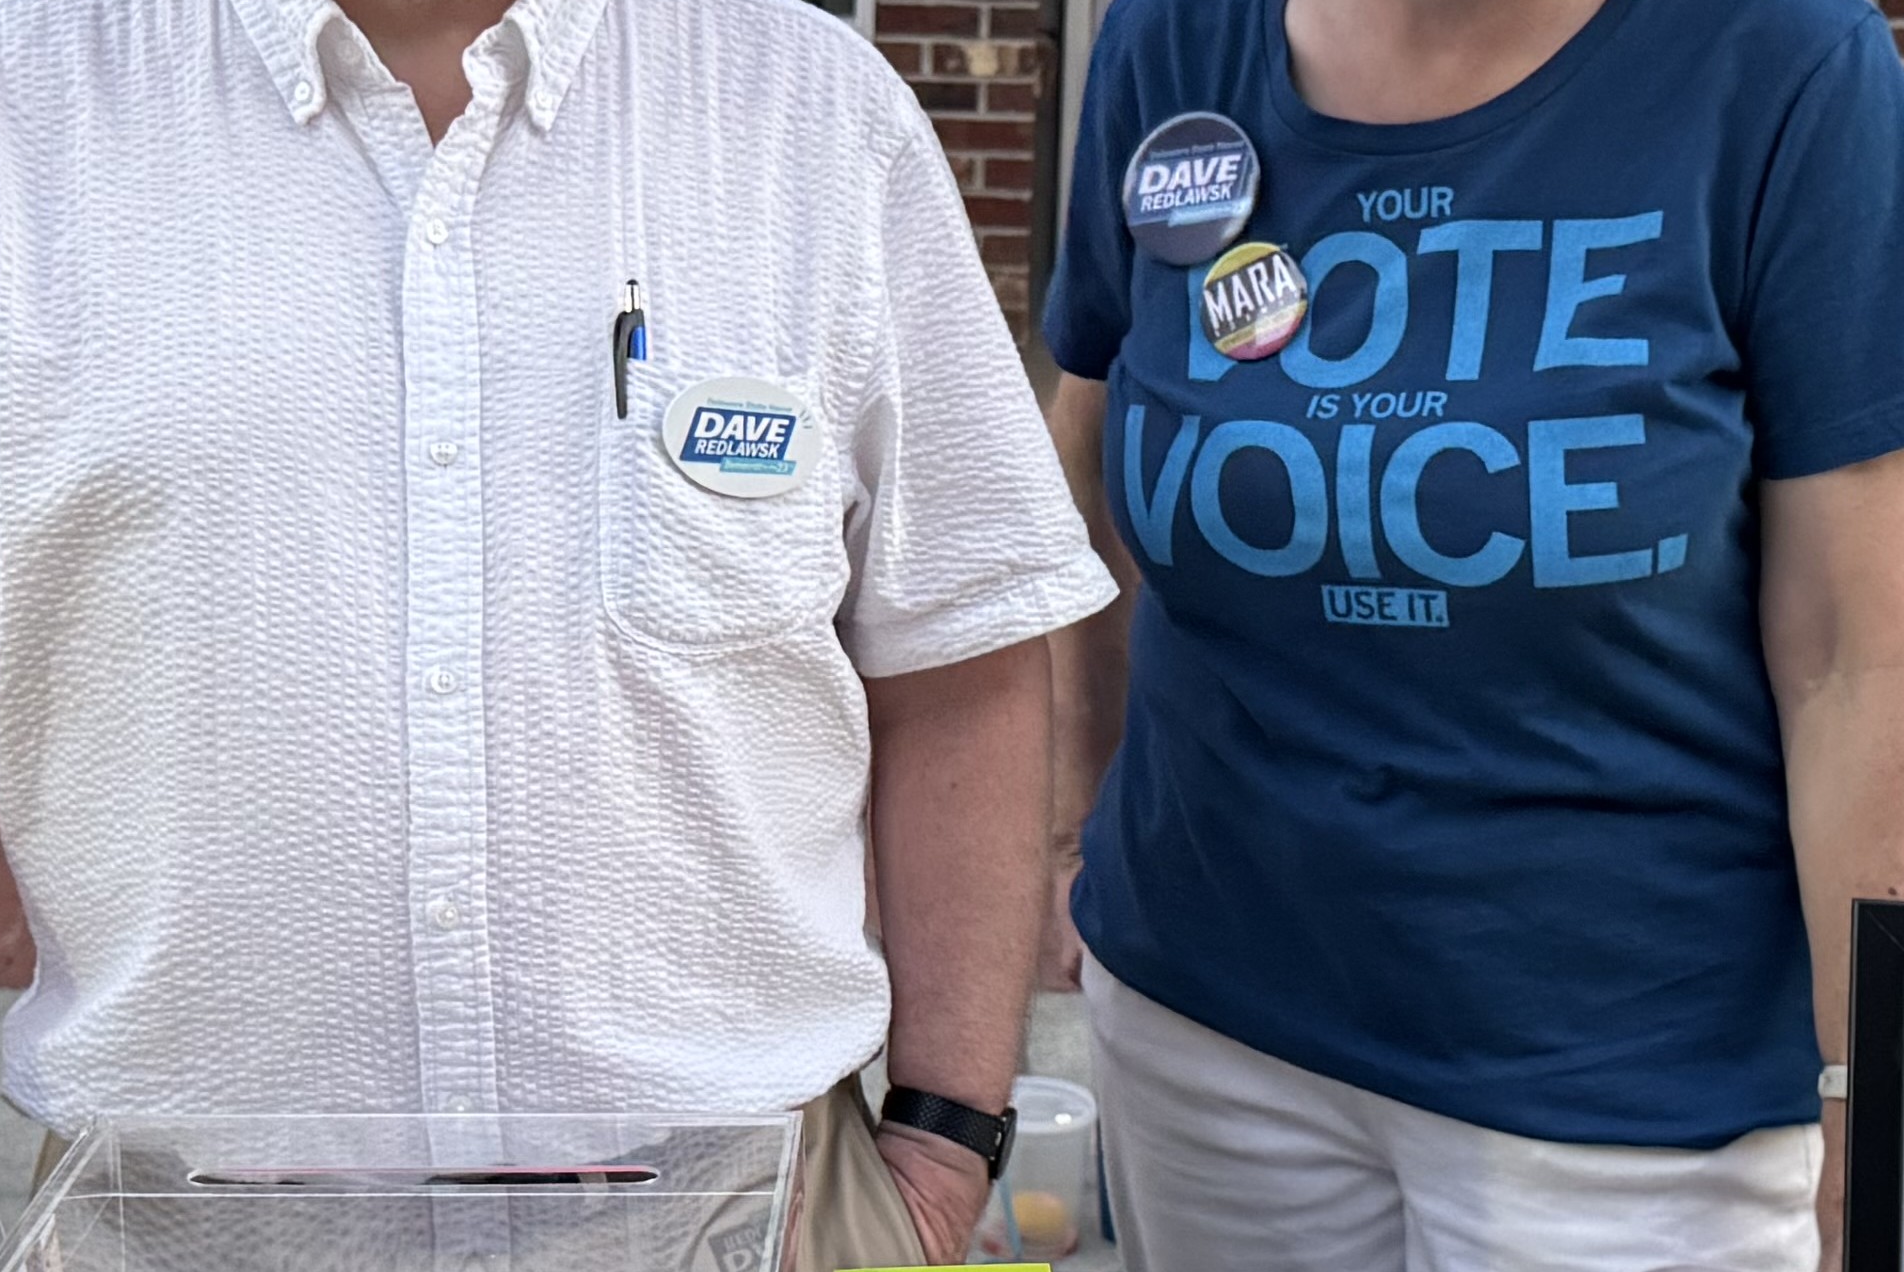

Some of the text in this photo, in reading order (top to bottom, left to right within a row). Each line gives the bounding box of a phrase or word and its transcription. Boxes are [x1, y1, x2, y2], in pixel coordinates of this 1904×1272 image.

[1139, 154, 1241, 195] DAVE
[1140, 182, 1233, 213] REDLAWSK
[1357, 187, 1454, 223] YOUR
[1204, 254, 1297, 332] MARA
[1307, 392, 1447, 419] IS YOUR
[694, 412, 790, 443] DAVE
[695, 440, 780, 458] REDLAWSK
[1124, 404, 1687, 588] VOICE.
[1330, 590, 1446, 623] USE IT.
